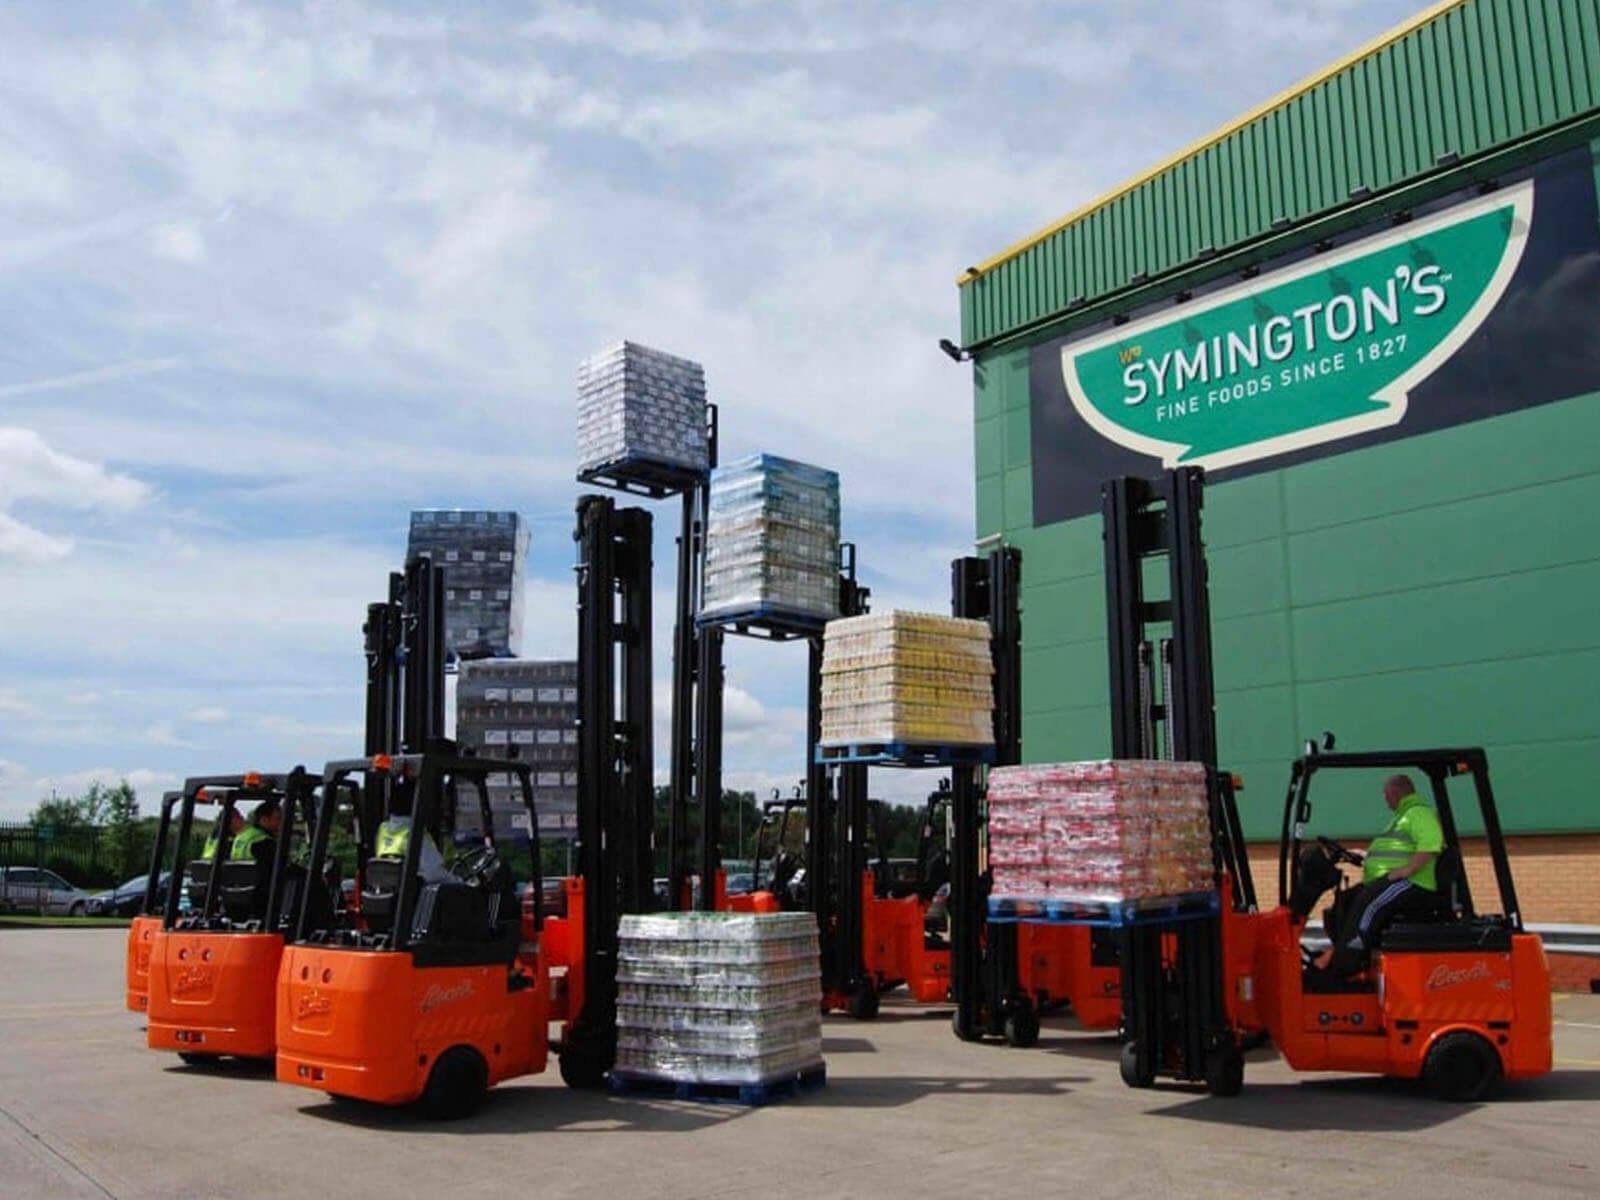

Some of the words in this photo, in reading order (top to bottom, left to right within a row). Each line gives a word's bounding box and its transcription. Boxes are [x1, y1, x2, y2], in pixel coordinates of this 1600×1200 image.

[1123, 264, 1446, 405] SYMINGTON'S
[1156, 396, 1200, 422] FINE
[1208, 374, 1272, 408] FOODS
[1280, 353, 1345, 386] SINCE
[1356, 334, 1407, 363] 1827
